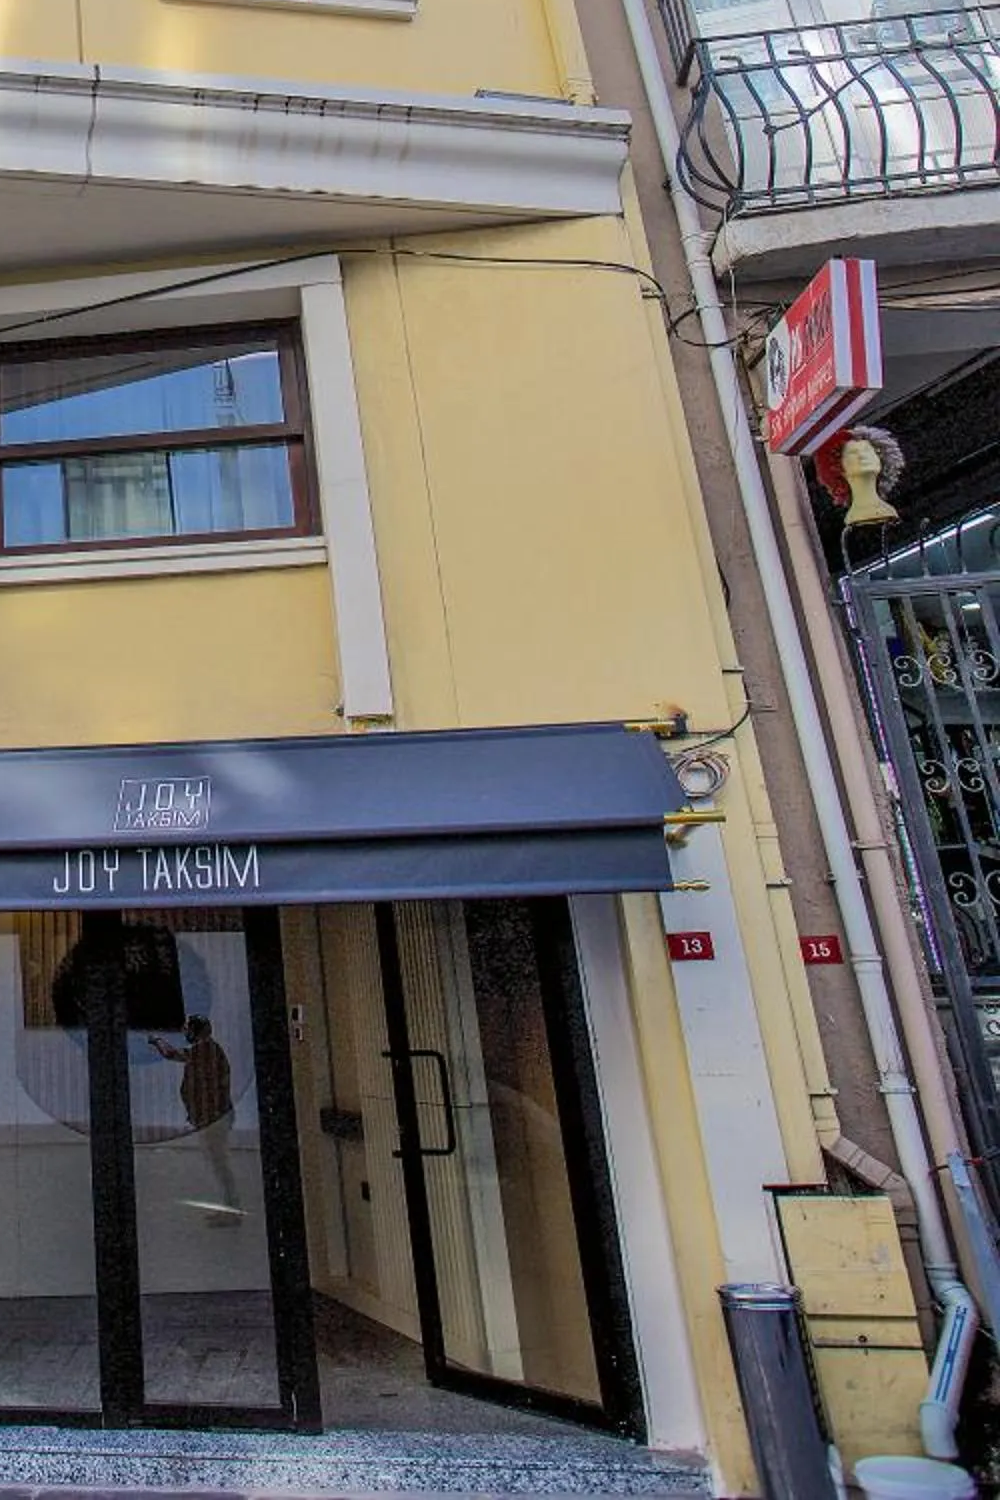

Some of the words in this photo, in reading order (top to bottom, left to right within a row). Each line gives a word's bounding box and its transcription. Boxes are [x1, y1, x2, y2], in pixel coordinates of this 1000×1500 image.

[125, 781, 203, 812] JOY
[53, 849, 119, 893] JOY
[681, 938, 703, 955] 13
[808, 942, 831, 958] 15
